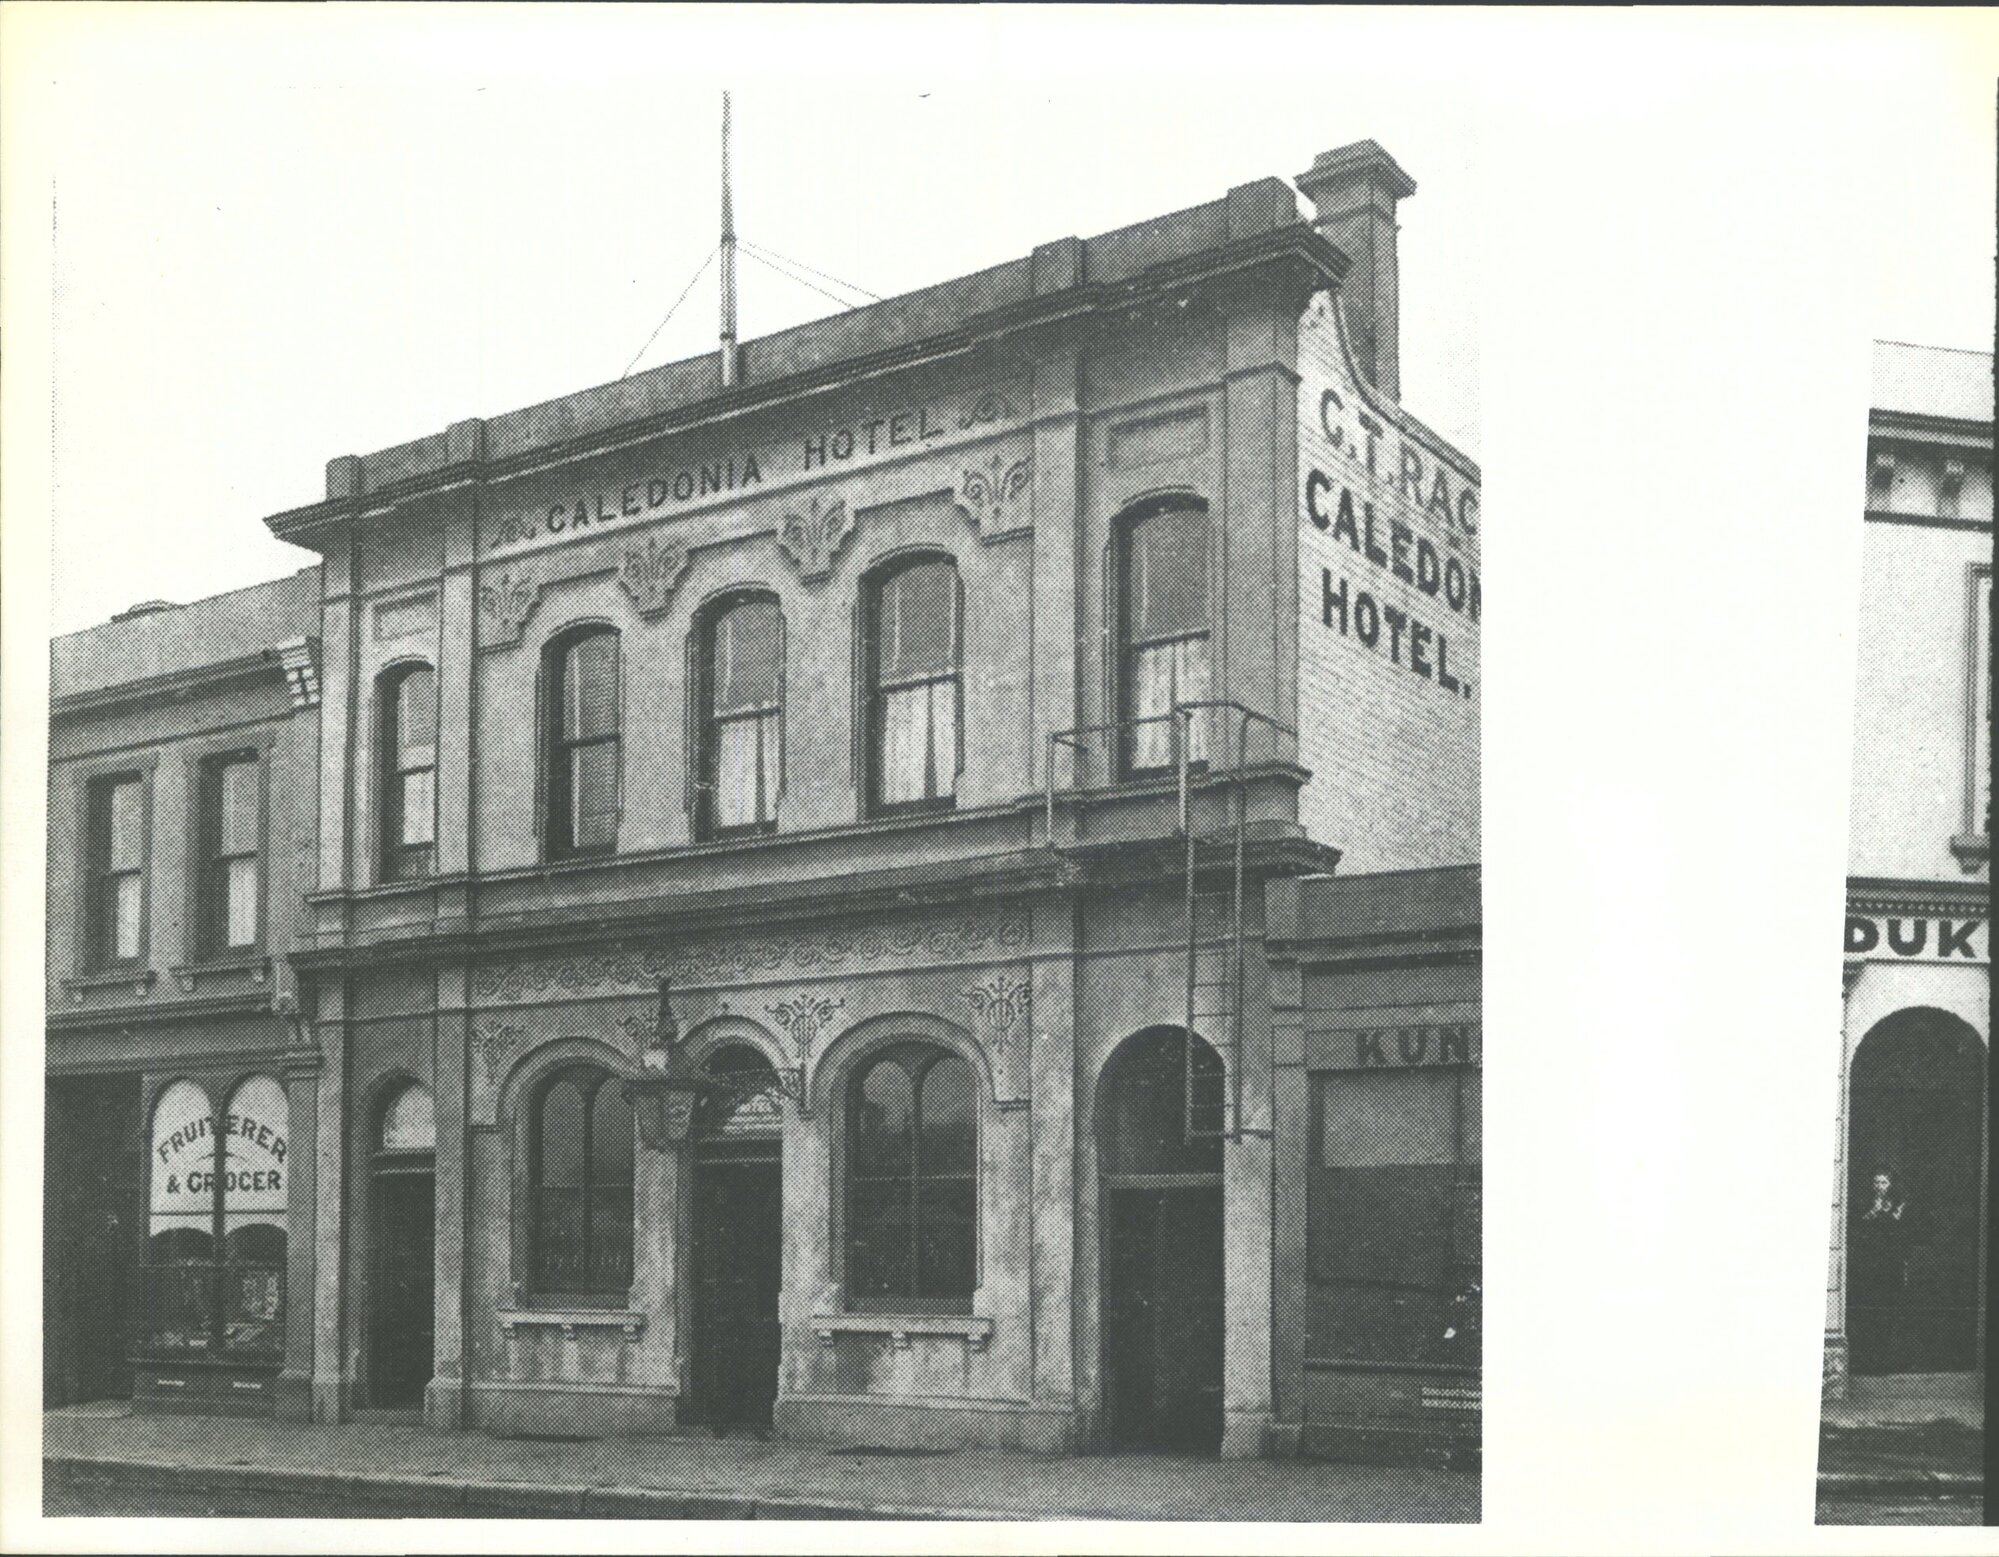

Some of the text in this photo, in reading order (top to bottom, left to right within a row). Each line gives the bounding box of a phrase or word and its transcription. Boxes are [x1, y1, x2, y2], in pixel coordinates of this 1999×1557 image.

[547, 407, 944, 533] CALEDONIA HOTEL
[1844, 916, 1980, 958] DUK
[1357, 1023, 1470, 1066] KUN
[166, 1170, 282, 1194] & GROCER
